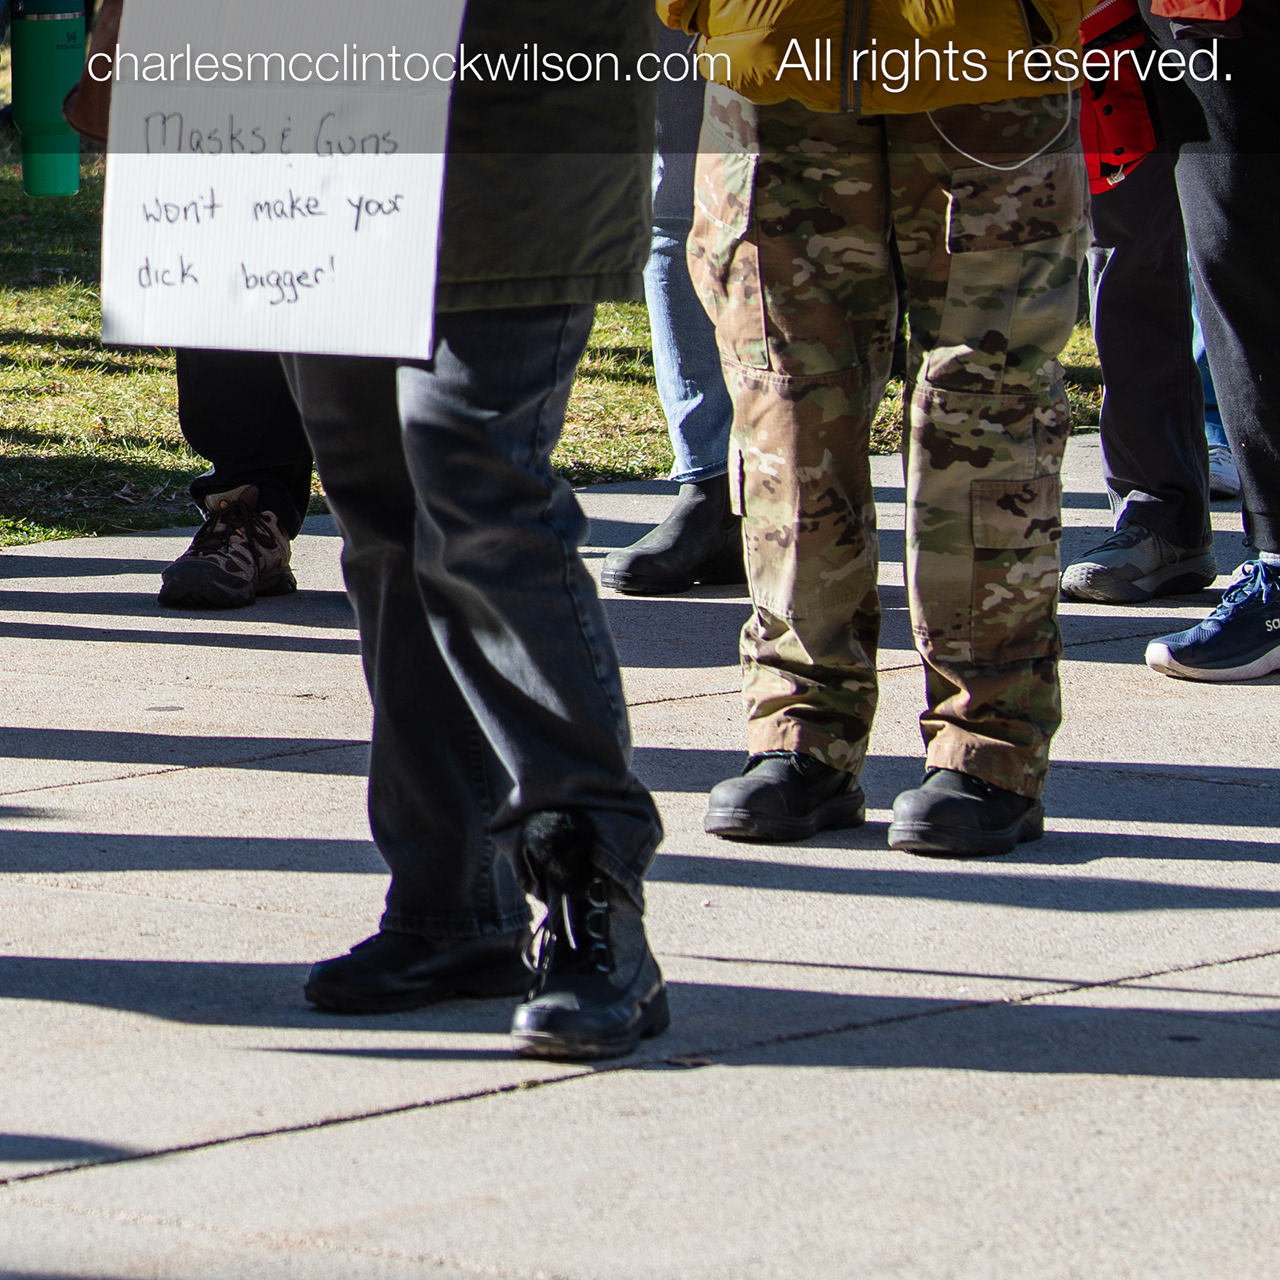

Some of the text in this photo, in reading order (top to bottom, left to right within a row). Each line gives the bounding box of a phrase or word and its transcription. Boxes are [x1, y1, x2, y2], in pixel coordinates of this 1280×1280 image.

[144, 111, 266, 155] Masks
[315, 112, 398, 158] Guns
[253, 188, 328, 221] make
[346, 192, 405, 232] your
[137, 255, 337, 305] dick bigger!
